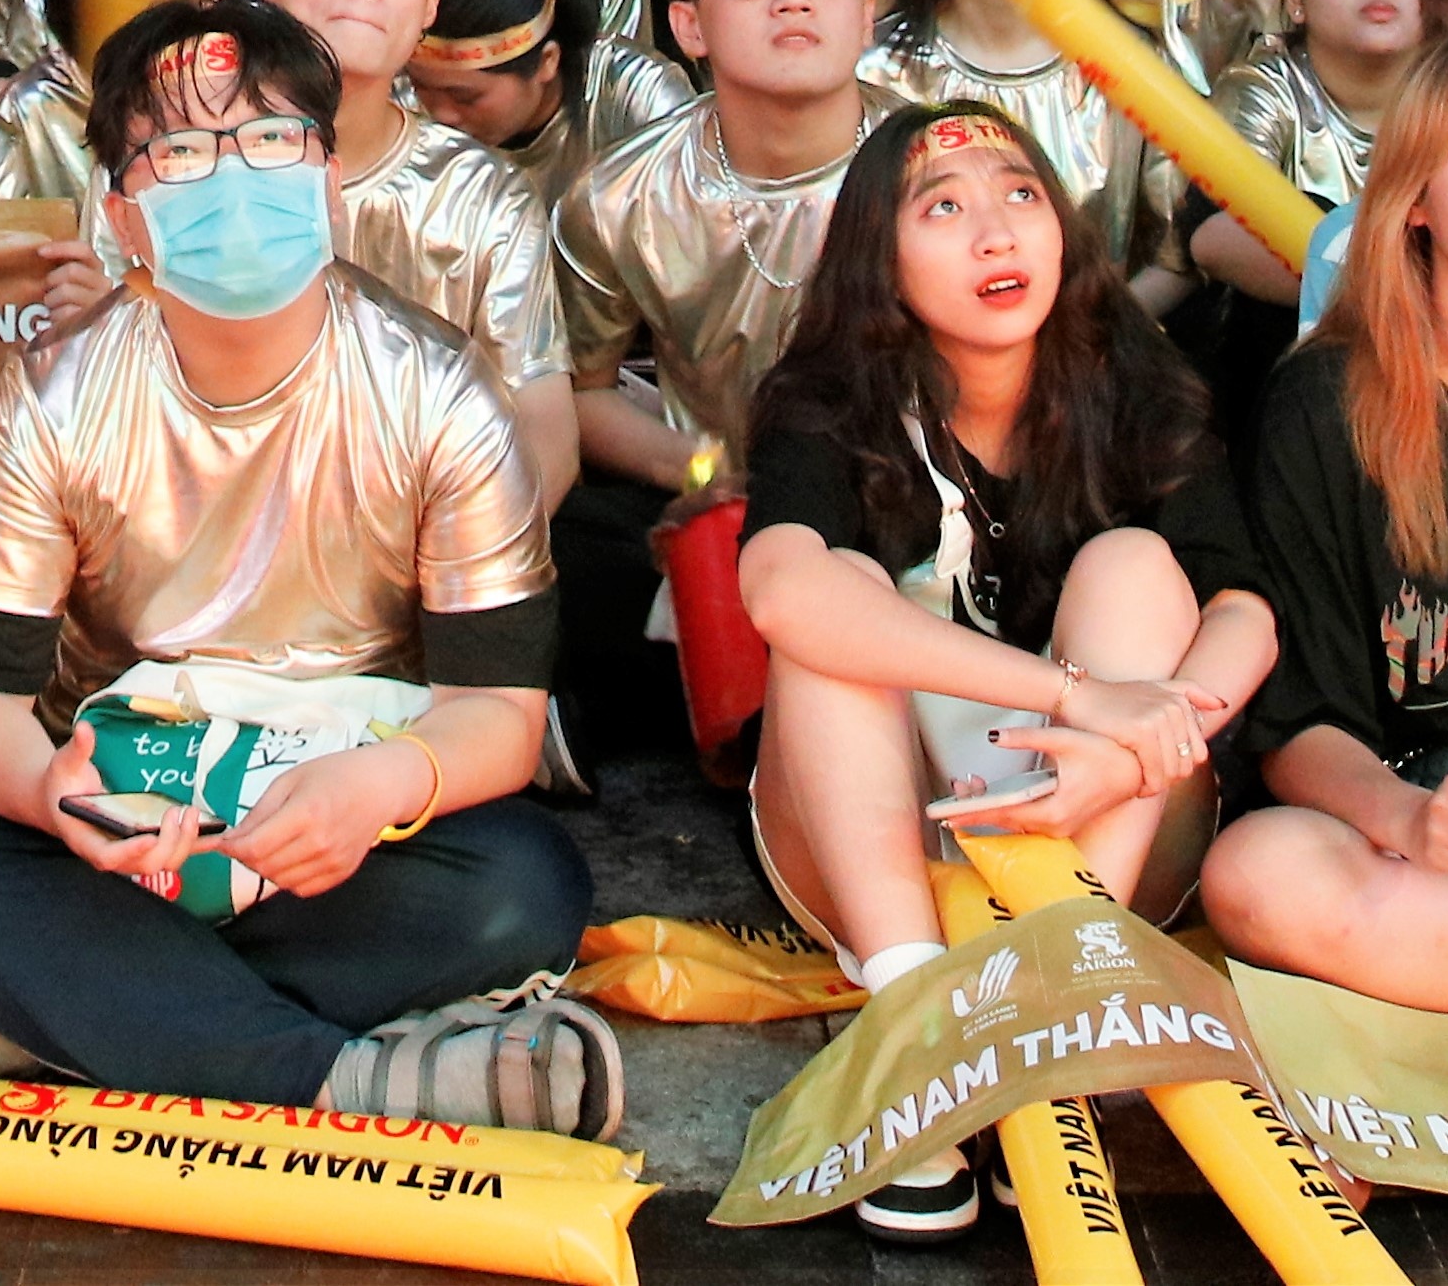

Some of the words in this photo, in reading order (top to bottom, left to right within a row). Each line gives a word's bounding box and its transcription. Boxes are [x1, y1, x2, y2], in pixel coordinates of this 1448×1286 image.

[132, 732, 170, 756] to
[1072, 958, 1136, 975] SAIGON
[759, 1126, 873, 1202] VIỆT
[881, 1045, 1001, 1153] NAM
[1012, 992, 1236, 1068] THẮNG
[1294, 1088, 1418, 1160] VIỆT
[113, 1129, 267, 1180] THẮNG
[282, 1151, 388, 1185] NAM
[1065, 1160, 1121, 1236] VIỆT
